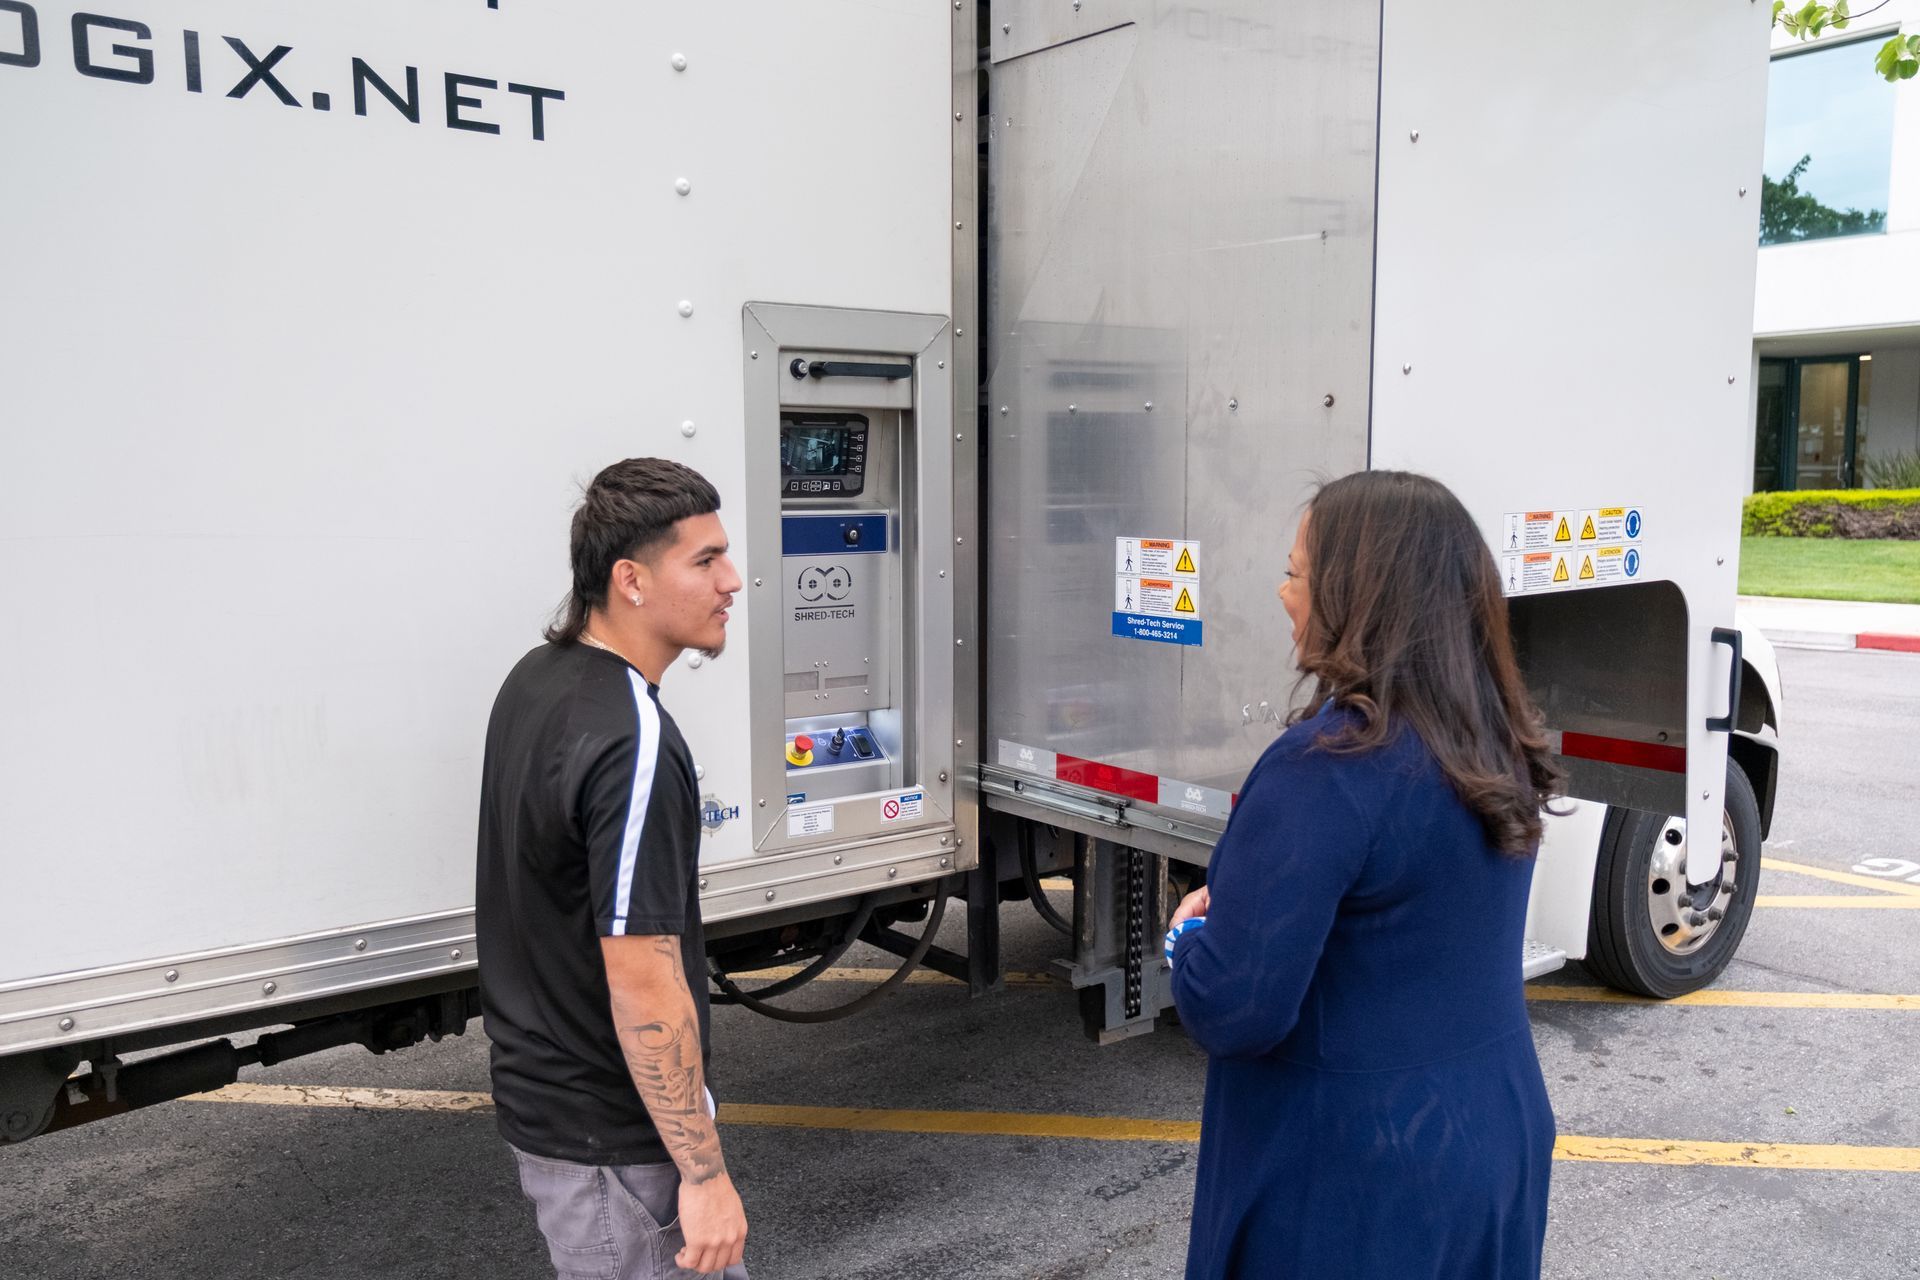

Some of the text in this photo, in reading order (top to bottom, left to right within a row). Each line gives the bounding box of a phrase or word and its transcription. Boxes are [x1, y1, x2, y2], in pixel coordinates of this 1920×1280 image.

[794, 609, 855, 622] SHRED-TECH
[1127, 616, 1185, 630] Shred-Tech Service
[1134, 628, 1178, 640] 1-800-465-3214
